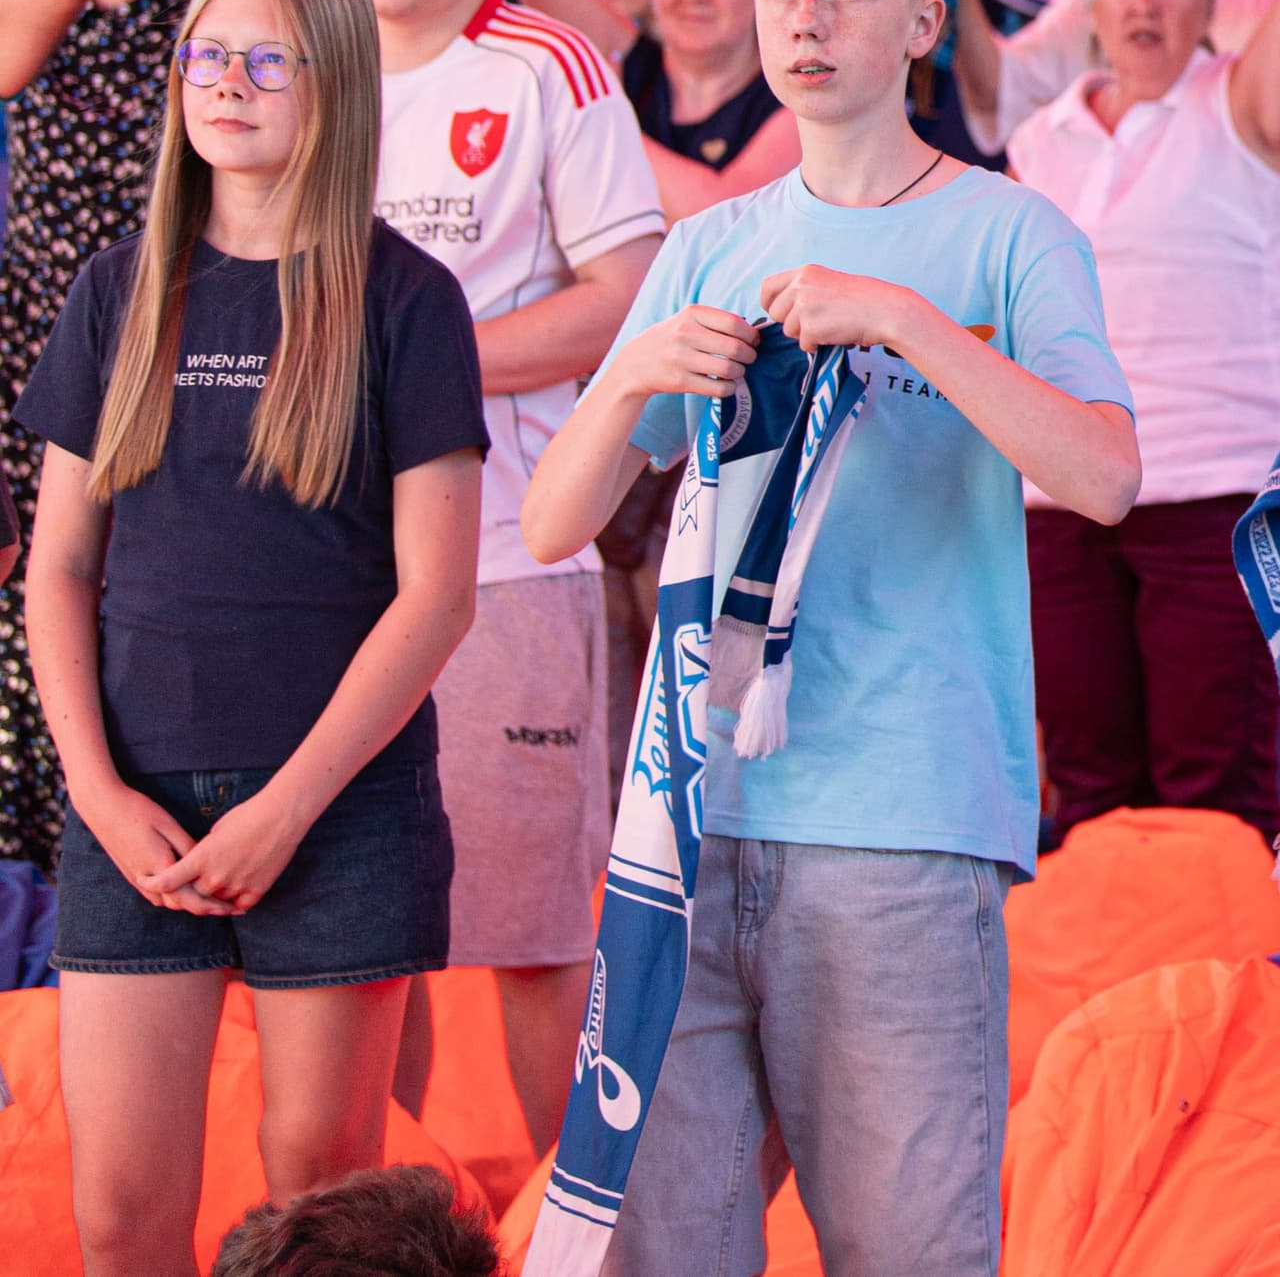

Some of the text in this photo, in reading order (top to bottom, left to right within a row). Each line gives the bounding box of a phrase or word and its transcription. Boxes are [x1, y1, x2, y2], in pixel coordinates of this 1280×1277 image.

[376, 193, 475, 220] andard
[186, 354, 268, 370] WHEN ART
[215, 373, 271, 389] FASHIO
